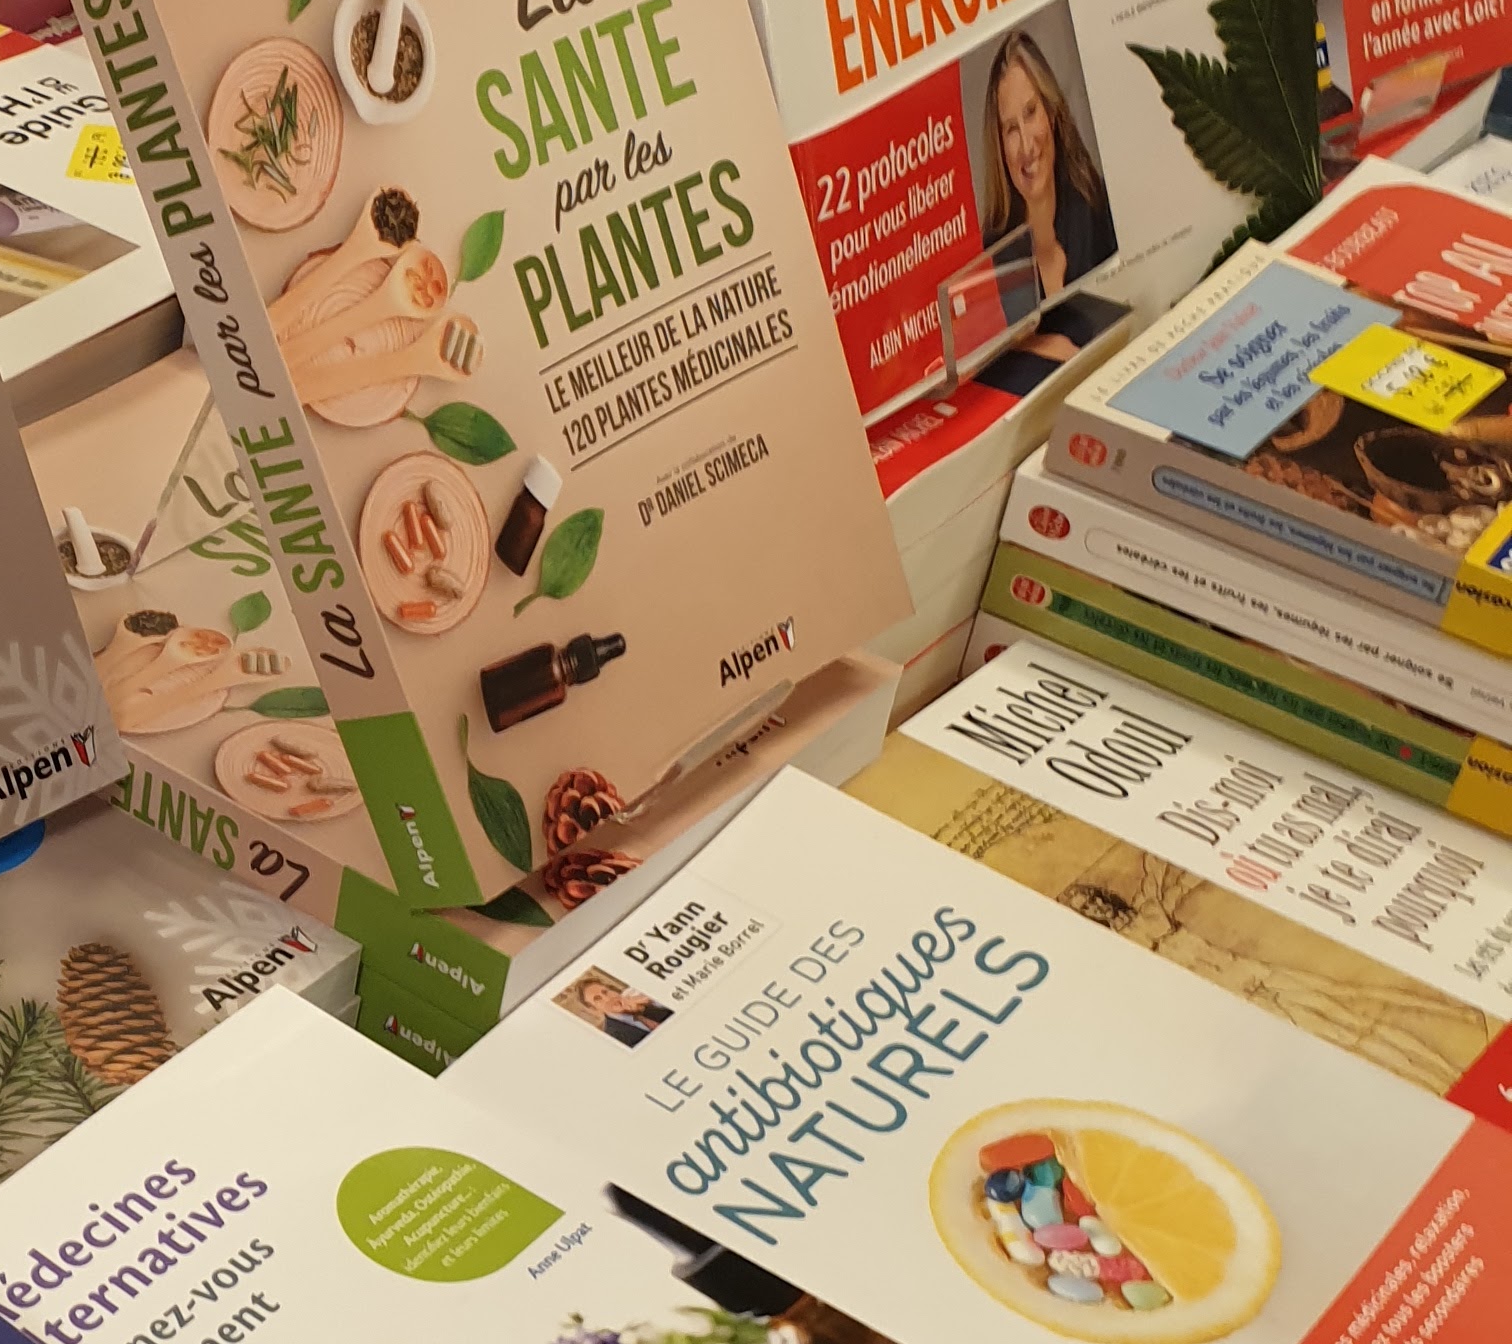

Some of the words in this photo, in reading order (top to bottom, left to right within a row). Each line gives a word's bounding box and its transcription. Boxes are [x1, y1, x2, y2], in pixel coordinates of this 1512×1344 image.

[1362, 17, 1421, 62] l'année
[1422, 6, 1462, 40] avec
[554, 156, 618, 236] par
[622, 127, 674, 182] les
[816, 165, 852, 222] 22
[857, 114, 955, 213] protocoles
[513, 157, 756, 351] PLANTES
[829, 224, 872, 277] pour
[907, 168, 956, 222] libérer
[560, 409, 598, 458] 120
[593, 369, 674, 439] PLANTES
[670, 307, 795, 397] MÉDICINALES
[568, 329, 656, 403] MEILLEUR
[704, 263, 784, 328] NATURE
[238, 414, 348, 598] SANTÉ
[653, 470, 708, 518] DANIEL
[704, 432, 771, 490] SCIMECA
[320, 602, 378, 682] La
[943, 661, 1111, 768] Michel
[1044, 703, 1194, 800] Odoul
[1155, 752, 1285, 848] Dis-moi
[1333, 804, 1423, 869] dirai
[644, 899, 707, 950] Yann
[644, 908, 730, 982] Rougier
[1371, 838, 1486, 953] pourquoi
[683, 953, 727, 992] Marie
[717, 917, 767, 961] Borrel
[644, 1068, 705, 1113] LE
[693, 980, 804, 1072] GUIDE
[788, 918, 866, 984] DES
[665, 905, 978, 1196] antibiotiques
[712, 935, 1051, 1247] NATURELS
